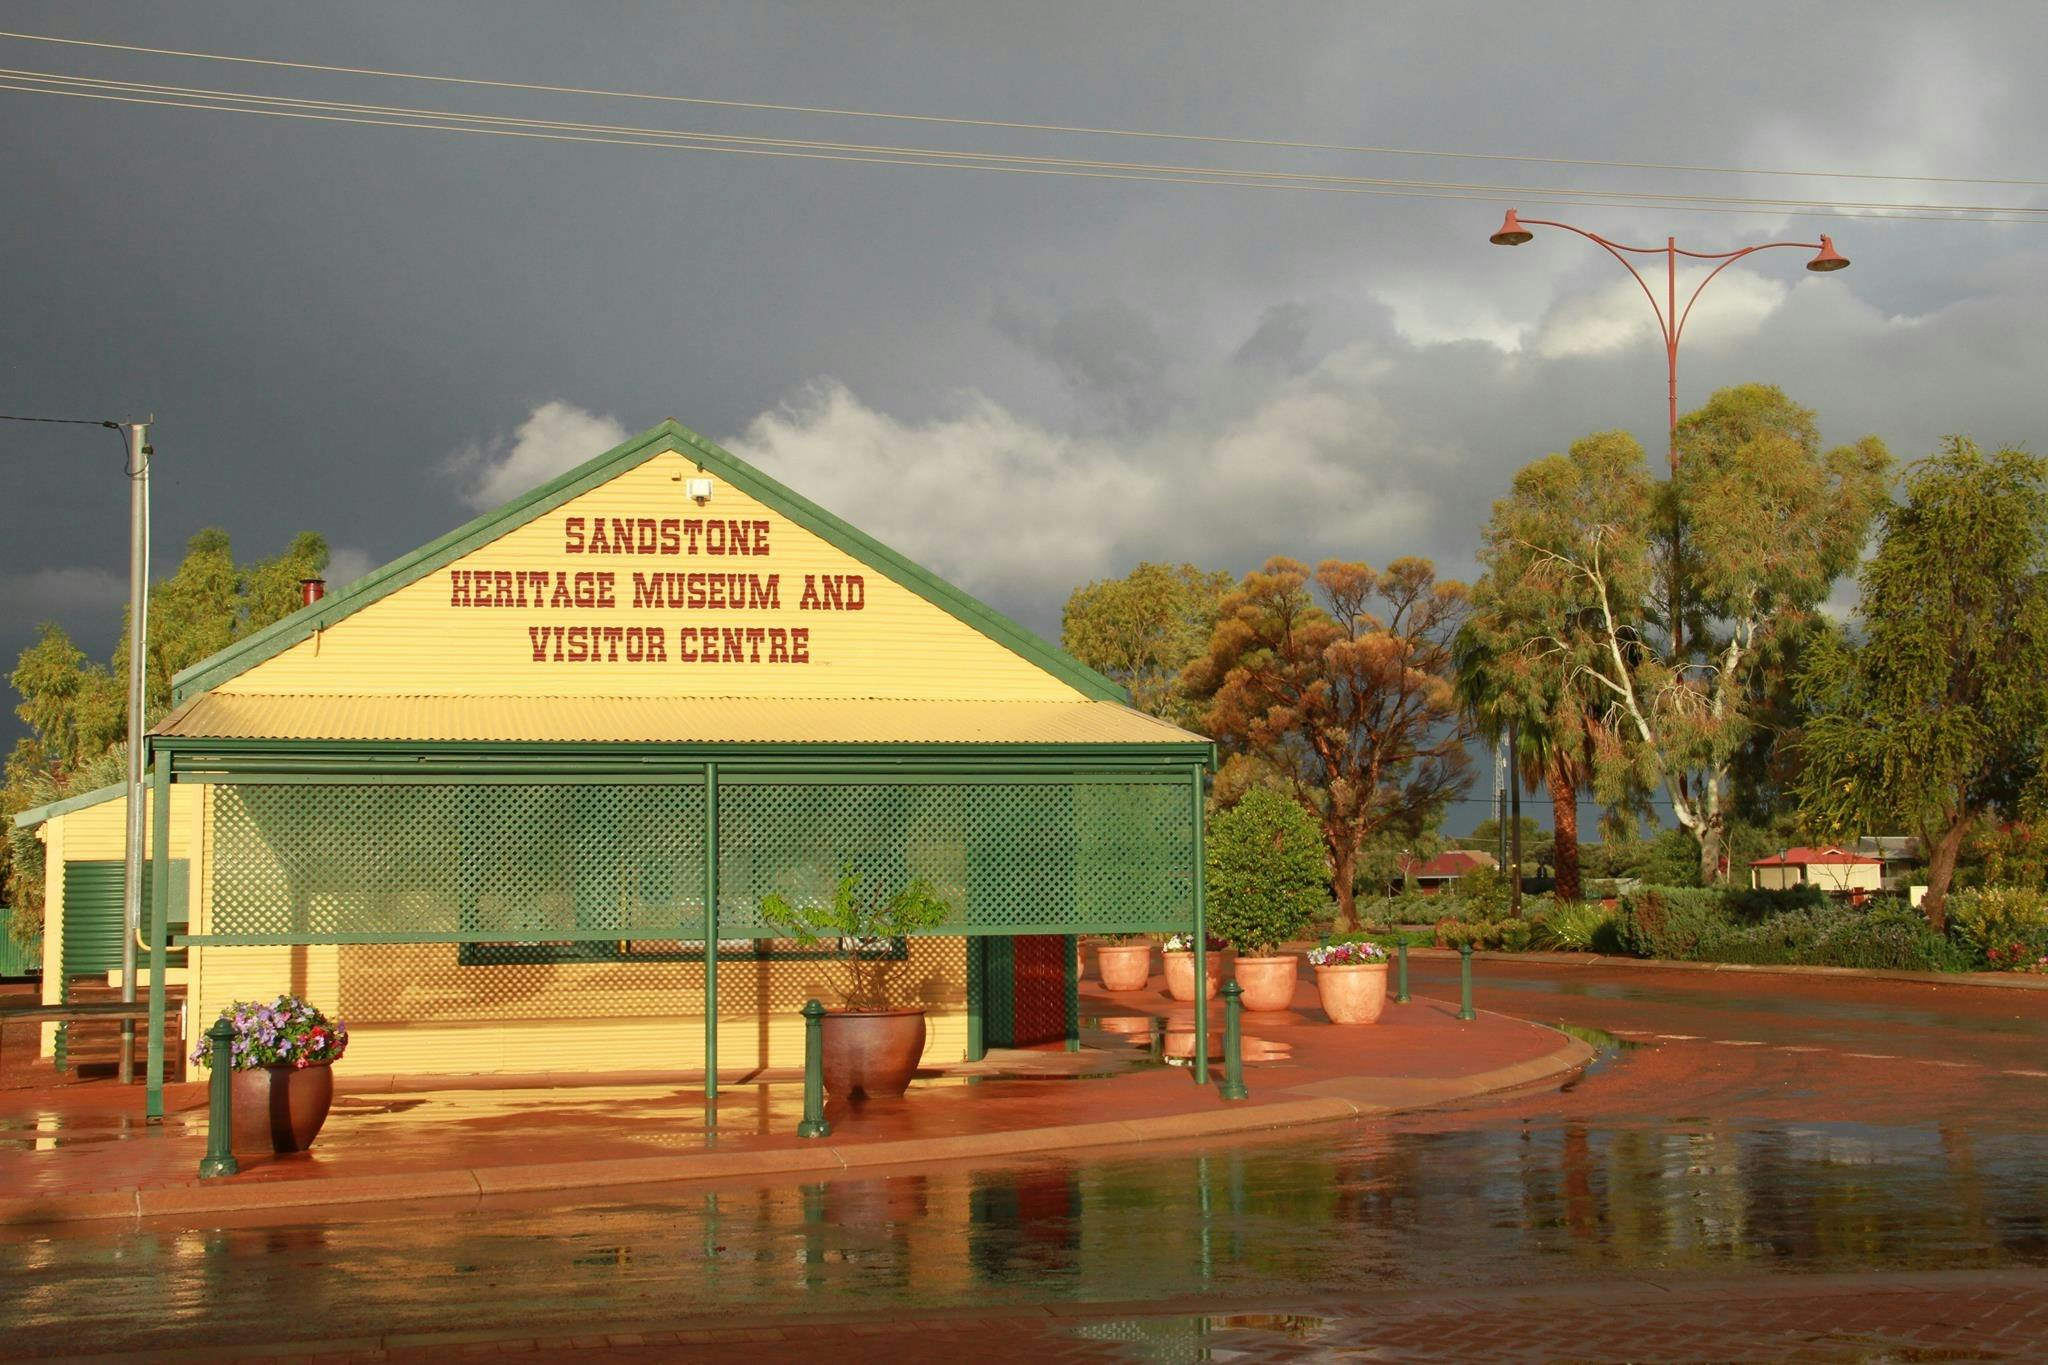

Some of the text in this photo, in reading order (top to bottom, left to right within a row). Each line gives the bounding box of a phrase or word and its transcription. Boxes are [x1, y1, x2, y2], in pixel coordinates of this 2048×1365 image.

[565, 517, 770, 556] SANDSTONE
[451, 570, 865, 611] HERITAGE MUSEUM AND
[528, 626, 810, 664] VISITOR CENTRE
